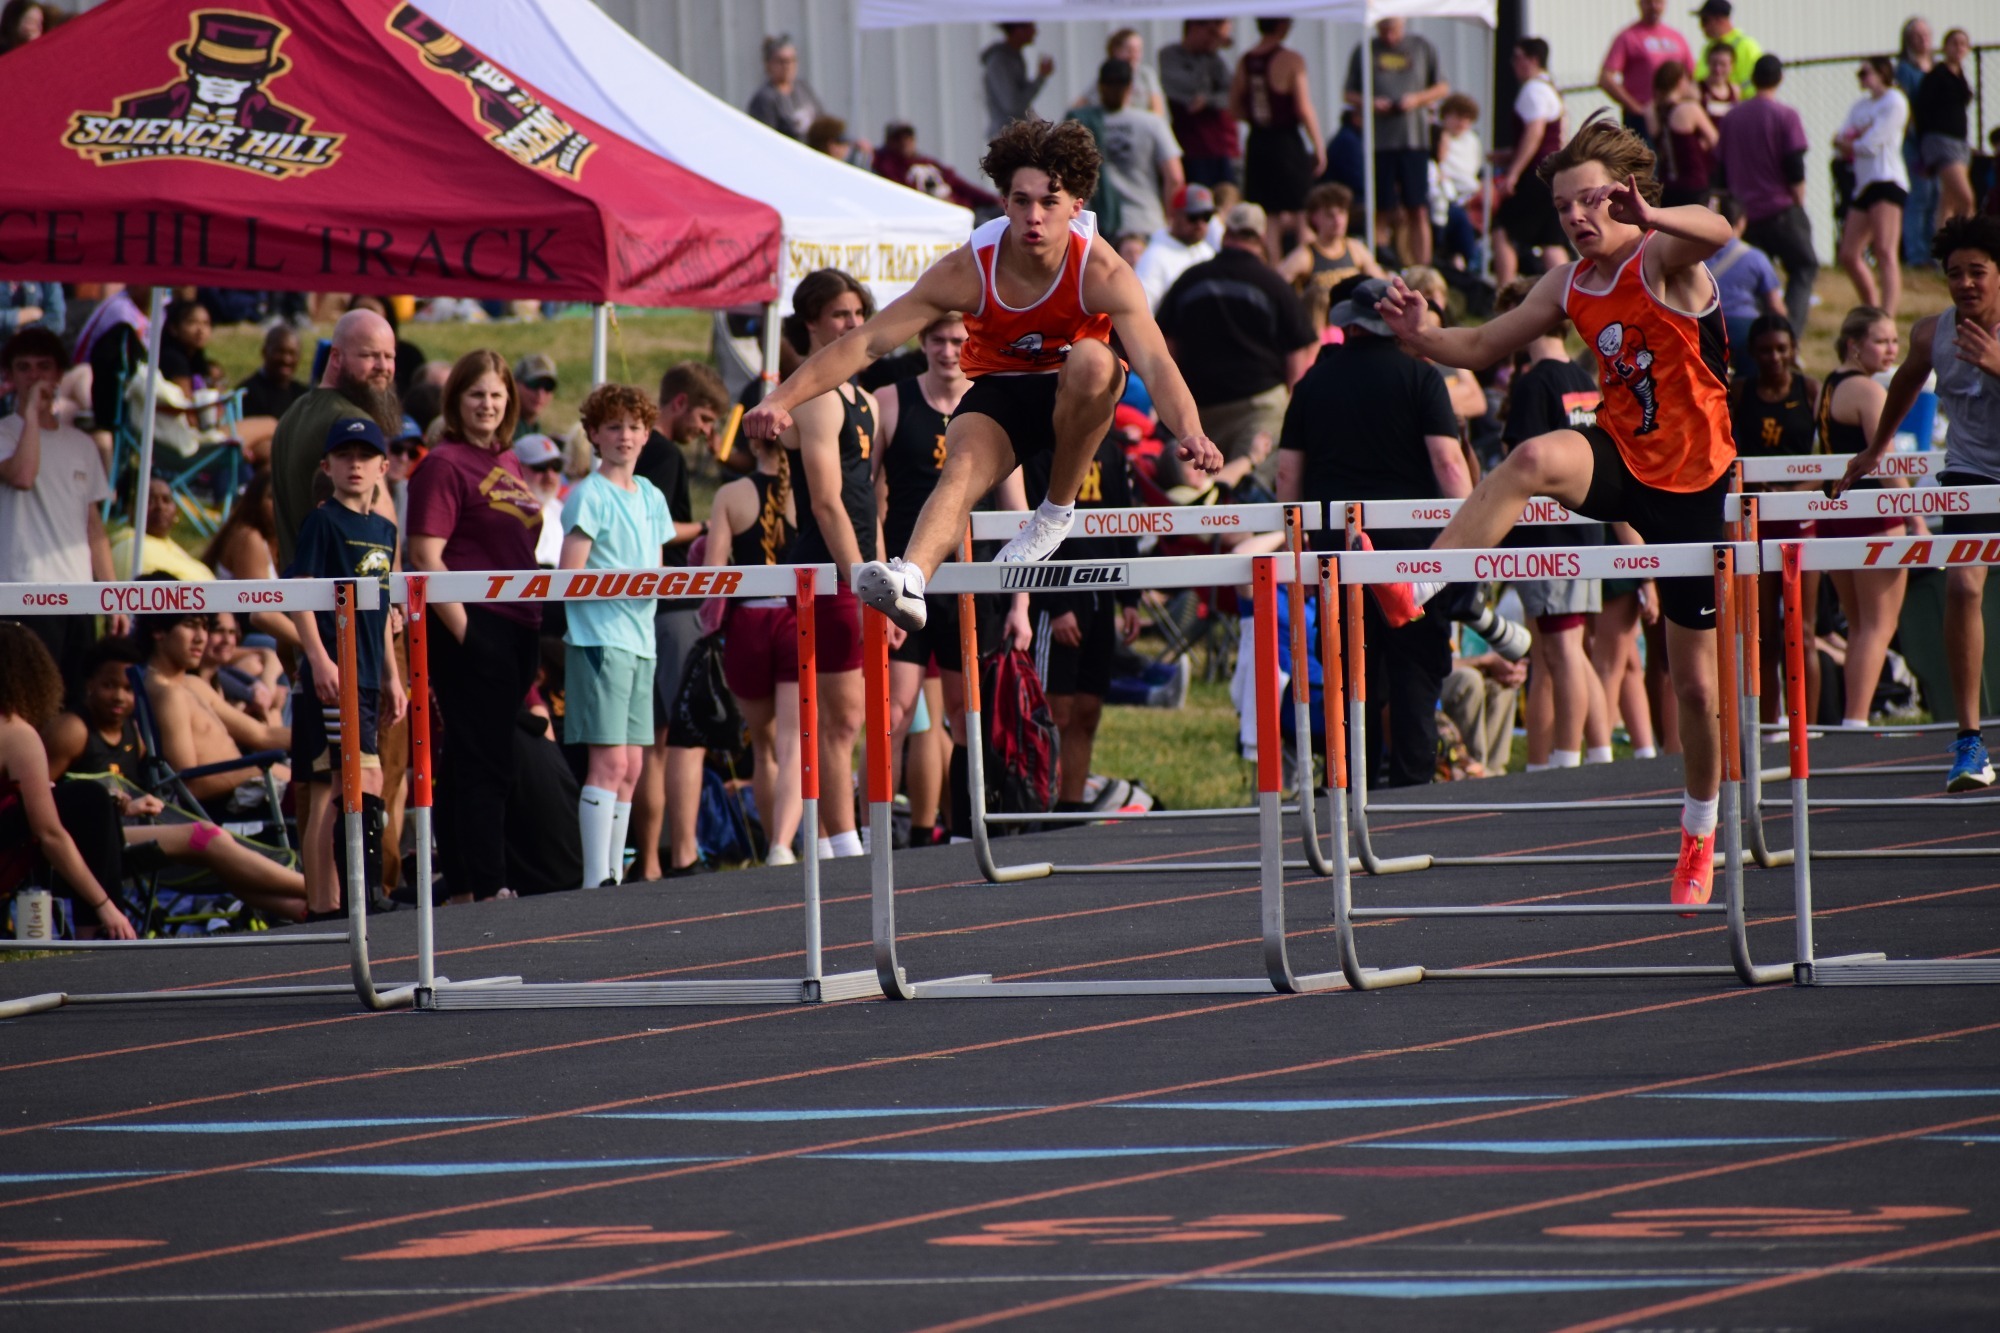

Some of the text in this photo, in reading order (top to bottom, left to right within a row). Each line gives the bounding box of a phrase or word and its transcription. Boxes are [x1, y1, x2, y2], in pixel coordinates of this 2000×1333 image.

[73, 115, 331, 164] SCIENCE HILL
[112, 145, 278, 174] HILLTOPPERS
[113, 211, 286, 273] HILL
[306, 222, 563, 282] TRACK
[1798, 464, 1822, 474] UCS
[1424, 509, 1451, 520] UCS
[1821, 491, 1970, 515] UCS CYCLONES
[1084, 512, 1240, 535] CYCLONES UCS
[1410, 553, 1660, 579] UCS CYCLONES UCS
[1863, 542, 1894, 566] T
[1899, 541, 1933, 565] A
[485, 571, 743, 599] T A DUGGER
[1073, 567, 1122, 585] GILL
[37, 587, 284, 612] UCS CYCLONES UCS
